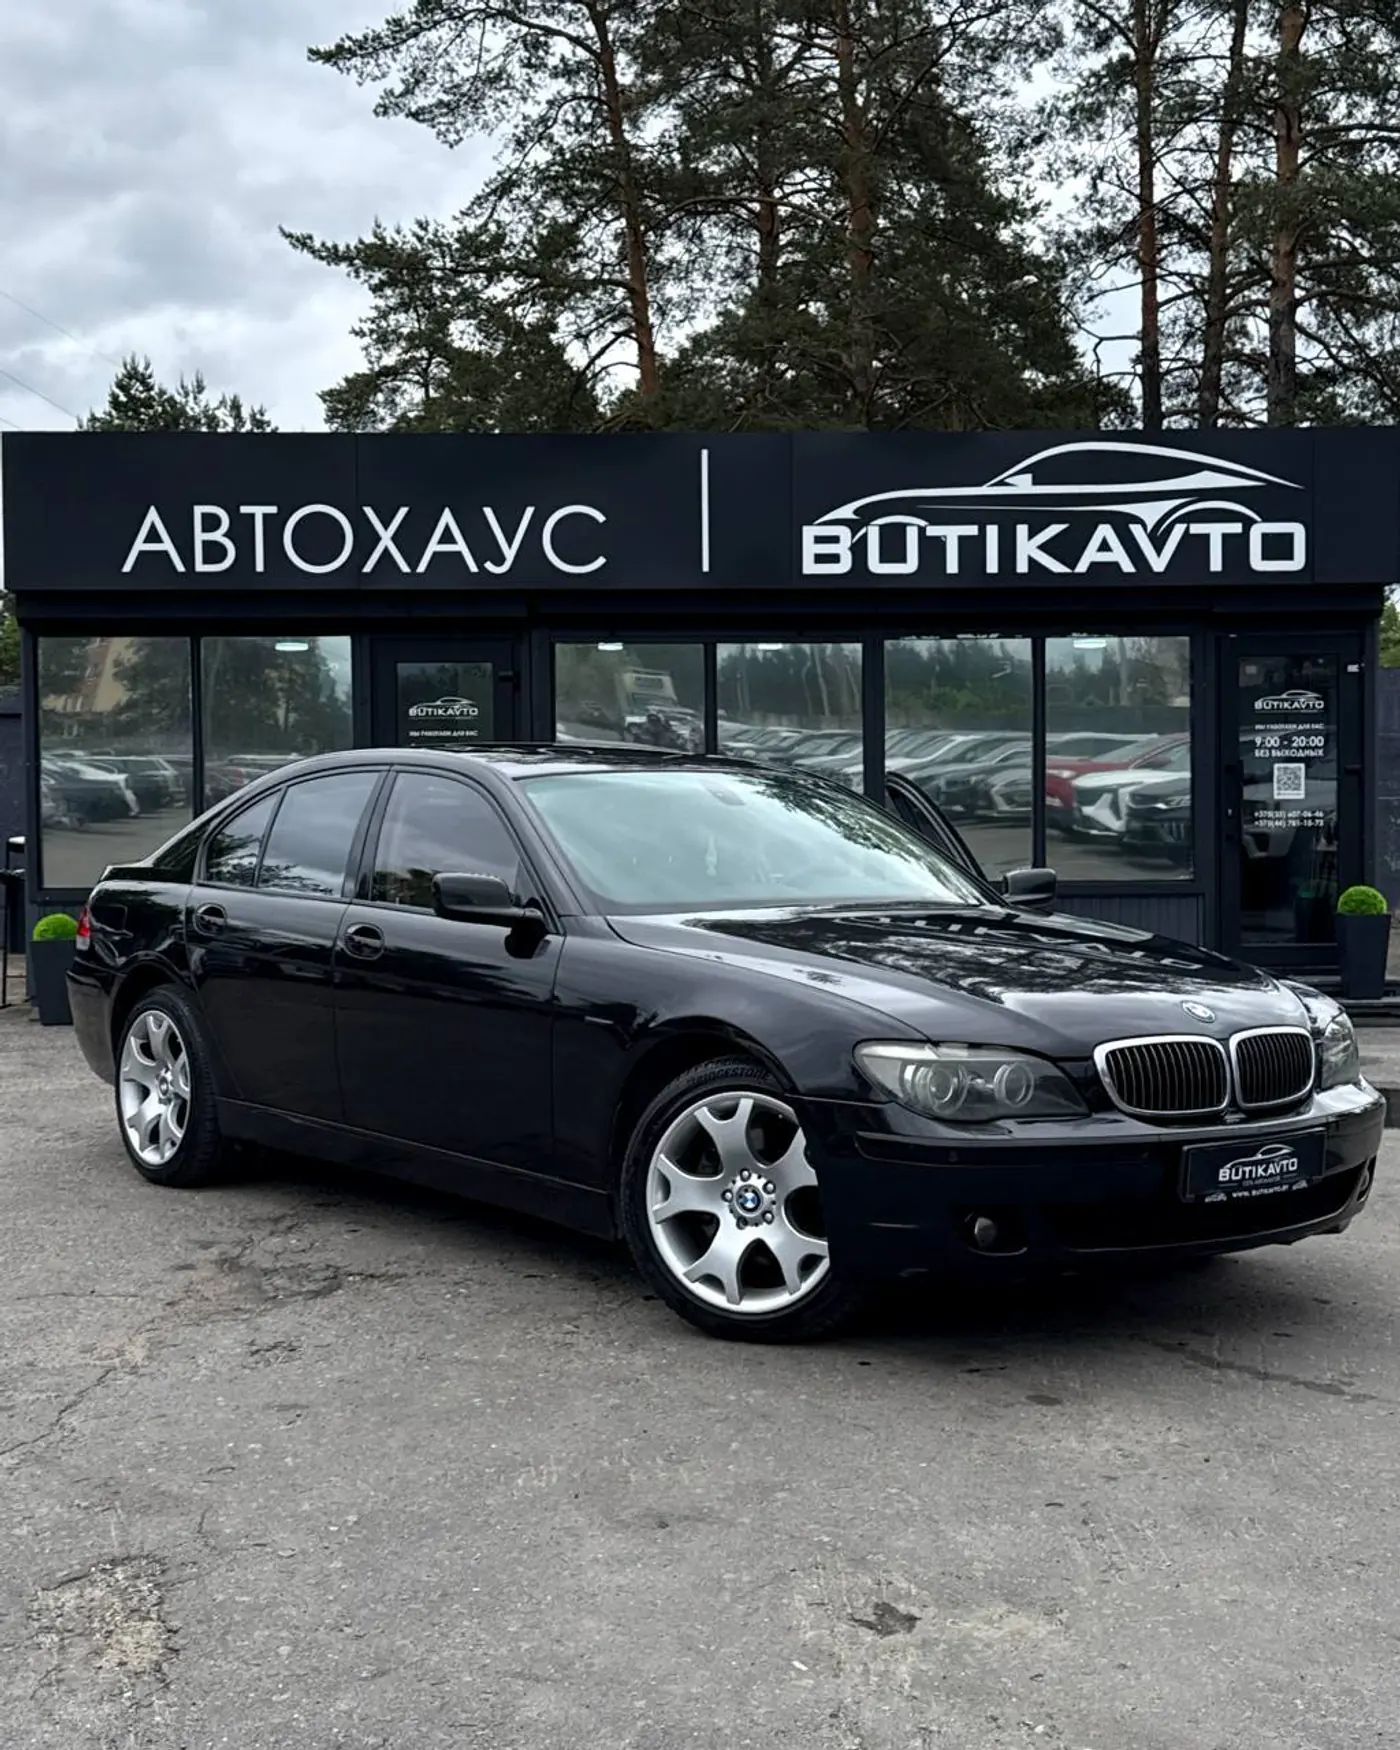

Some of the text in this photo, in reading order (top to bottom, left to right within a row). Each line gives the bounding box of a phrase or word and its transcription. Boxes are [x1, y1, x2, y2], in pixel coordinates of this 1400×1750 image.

[121, 504, 607, 575] АВТОХАУС
[802, 521, 1307, 576] BUTIKAVTO
[1254, 700, 1325, 710] BUTIKAVTO
[408, 707, 479, 717] BUTIKAVTO
[1255, 736, 1280, 748] 9:00
[1292, 736, 1325, 747] 20:00
[1254, 749, 1325, 757] БЕЗ ВЫХОДНЫХ
[1218, 1157, 1299, 1182] BUTIKAVTO
